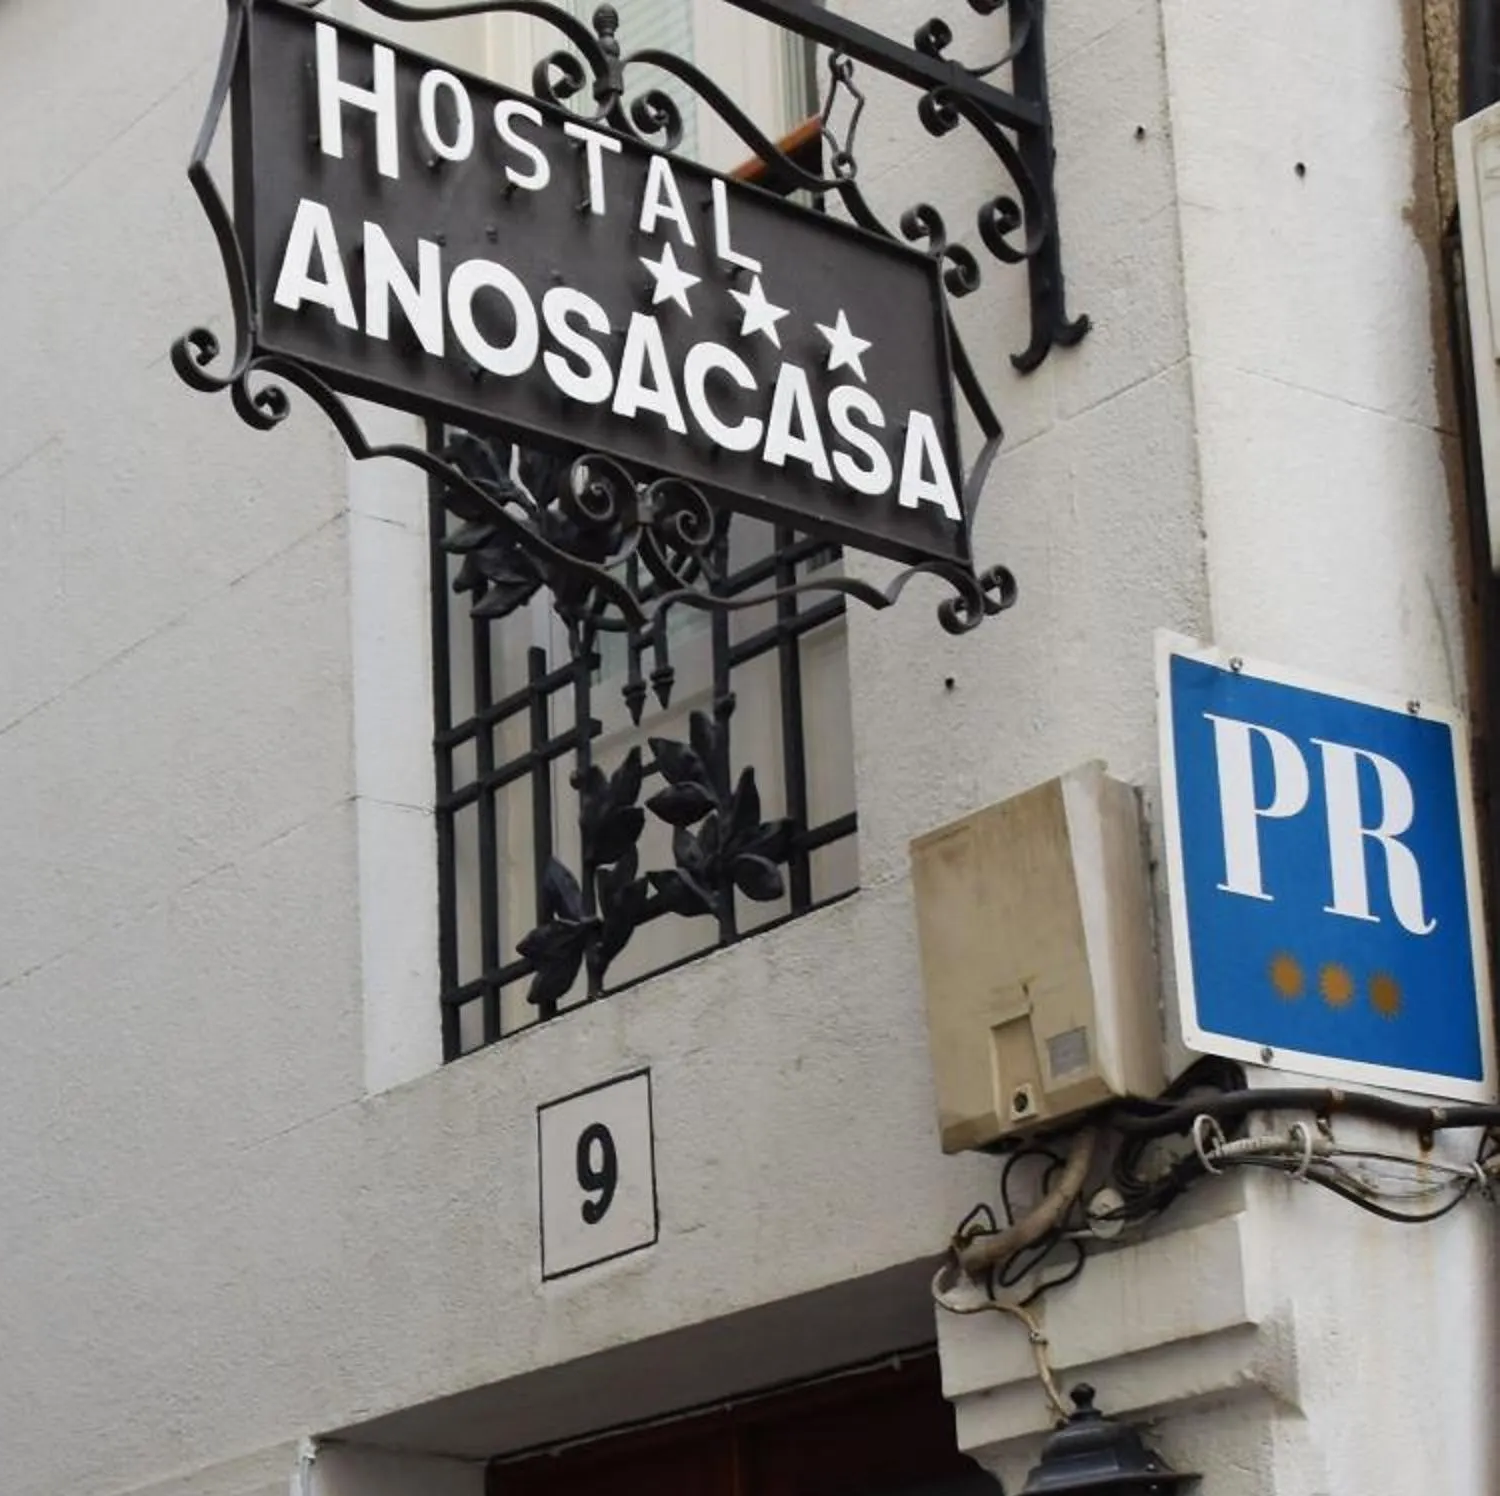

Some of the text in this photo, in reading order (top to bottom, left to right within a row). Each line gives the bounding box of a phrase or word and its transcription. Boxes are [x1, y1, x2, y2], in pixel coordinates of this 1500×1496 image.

[315, 22, 762, 274] HOSTAL
[274, 199, 962, 522] ANOSACASA
[1204, 712, 1436, 935] PR
[576, 1122, 618, 1225] 9
